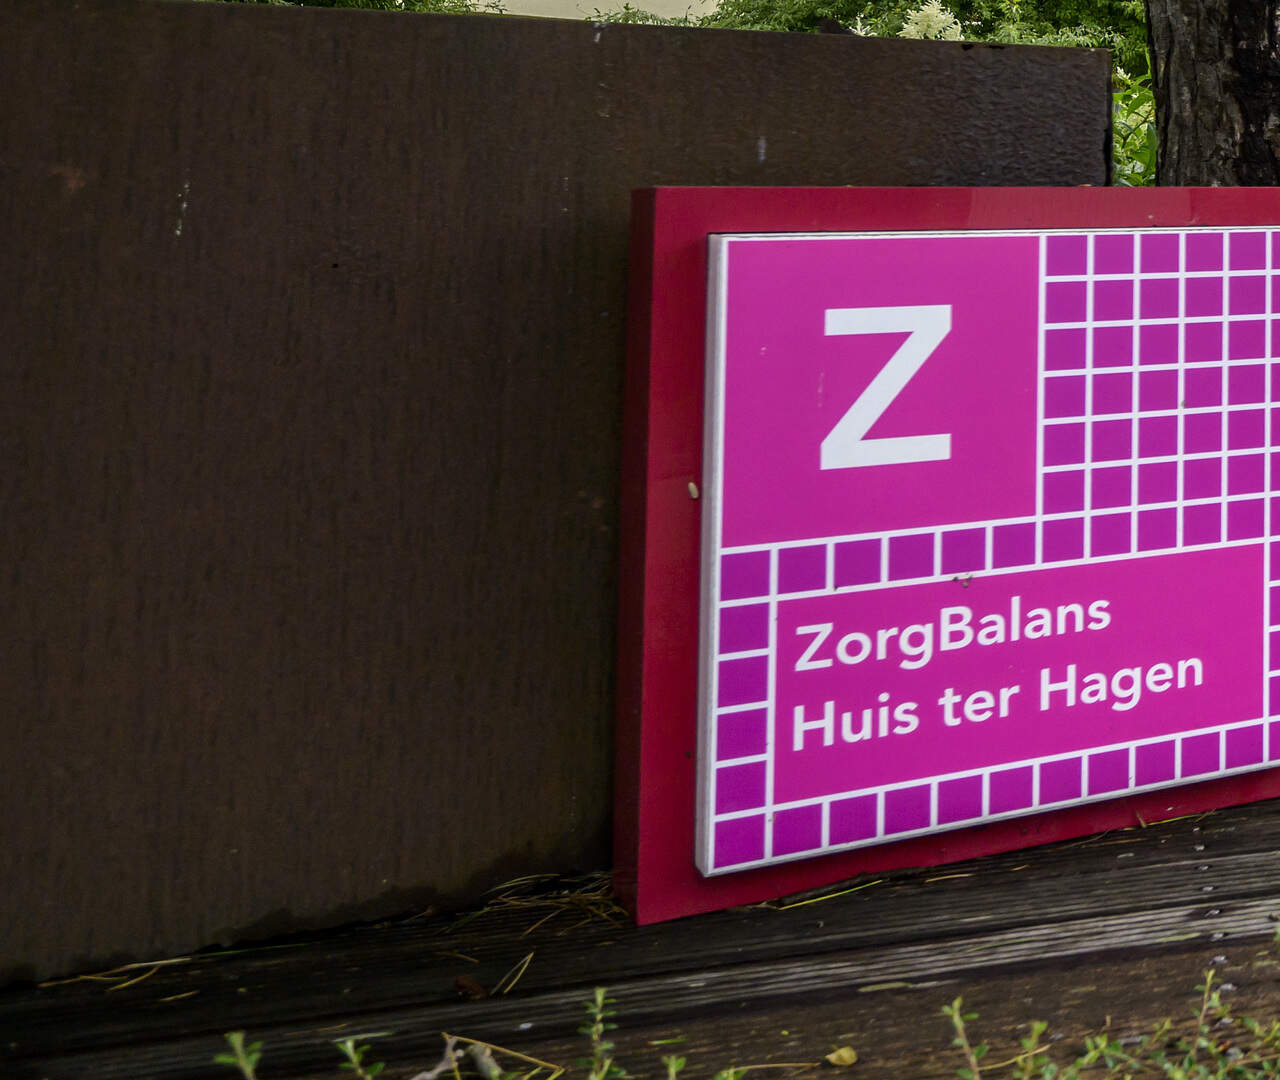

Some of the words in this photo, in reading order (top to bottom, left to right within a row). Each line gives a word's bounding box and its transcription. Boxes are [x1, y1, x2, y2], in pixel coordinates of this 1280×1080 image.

[820, 304, 952, 470] Z
[794, 595, 1112, 672] ZorgBalans
[792, 692, 920, 752] Huis
[938, 684, 1021, 727] ter
[1039, 657, 1203, 712] Hagen
